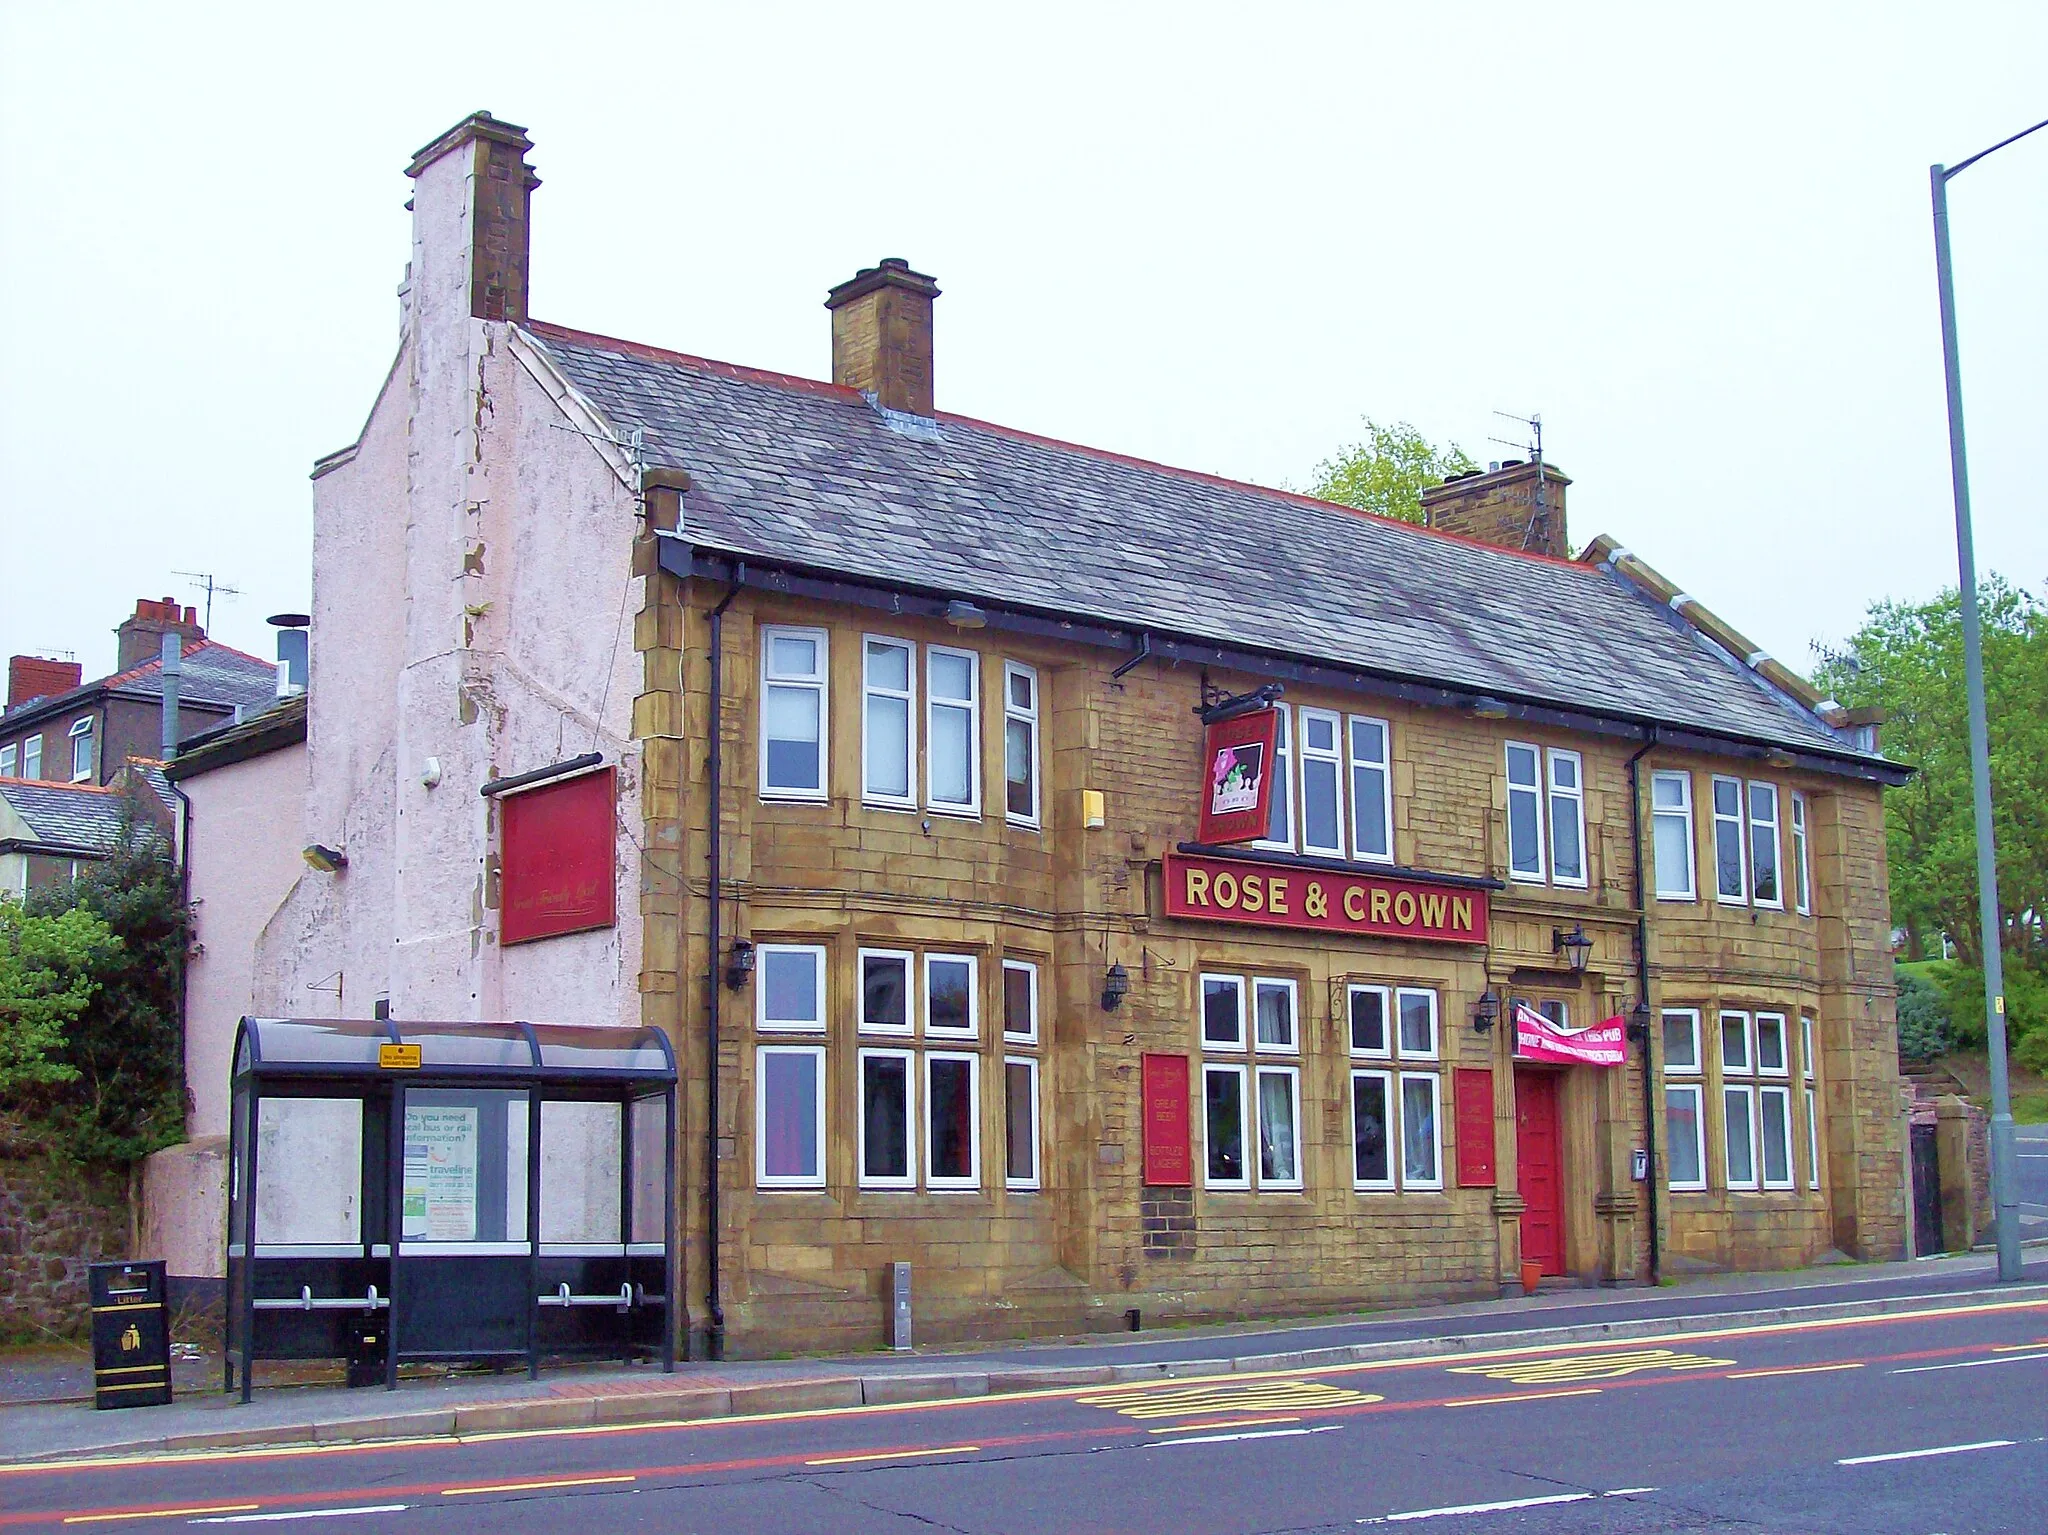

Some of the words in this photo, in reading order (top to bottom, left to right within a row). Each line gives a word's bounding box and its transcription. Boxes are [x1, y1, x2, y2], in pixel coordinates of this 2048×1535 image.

[1185, 868, 1289, 914] ROSE
[1304, 881, 1328, 919] &
[1343, 885, 1473, 931] CROWN
[1603, 1028, 1622, 1042] PUB
[421, 1114, 439, 1125] you
[406, 1123, 421, 1131] cal
[430, 1165, 472, 1174] traveline
[1445, 1349, 1738, 1384] BUS
[1075, 1381, 1385, 1419] STOP
